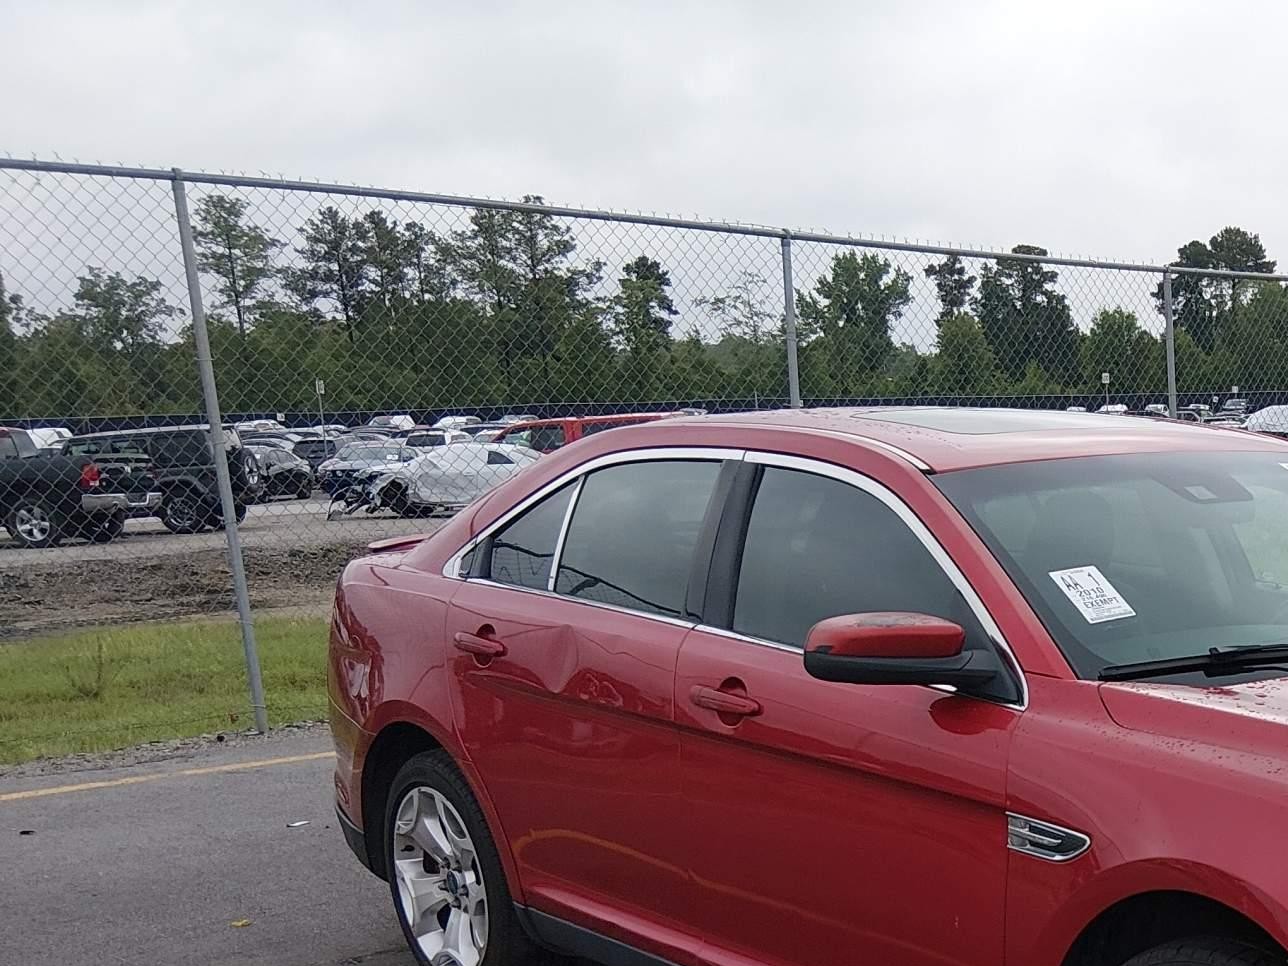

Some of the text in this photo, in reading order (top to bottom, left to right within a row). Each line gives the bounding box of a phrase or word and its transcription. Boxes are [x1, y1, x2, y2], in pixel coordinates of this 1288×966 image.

[1060, 572, 1100, 592] AA 1
[1076, 587, 1104, 597] 2010
[1083, 597, 1119, 608] EXEMPT
